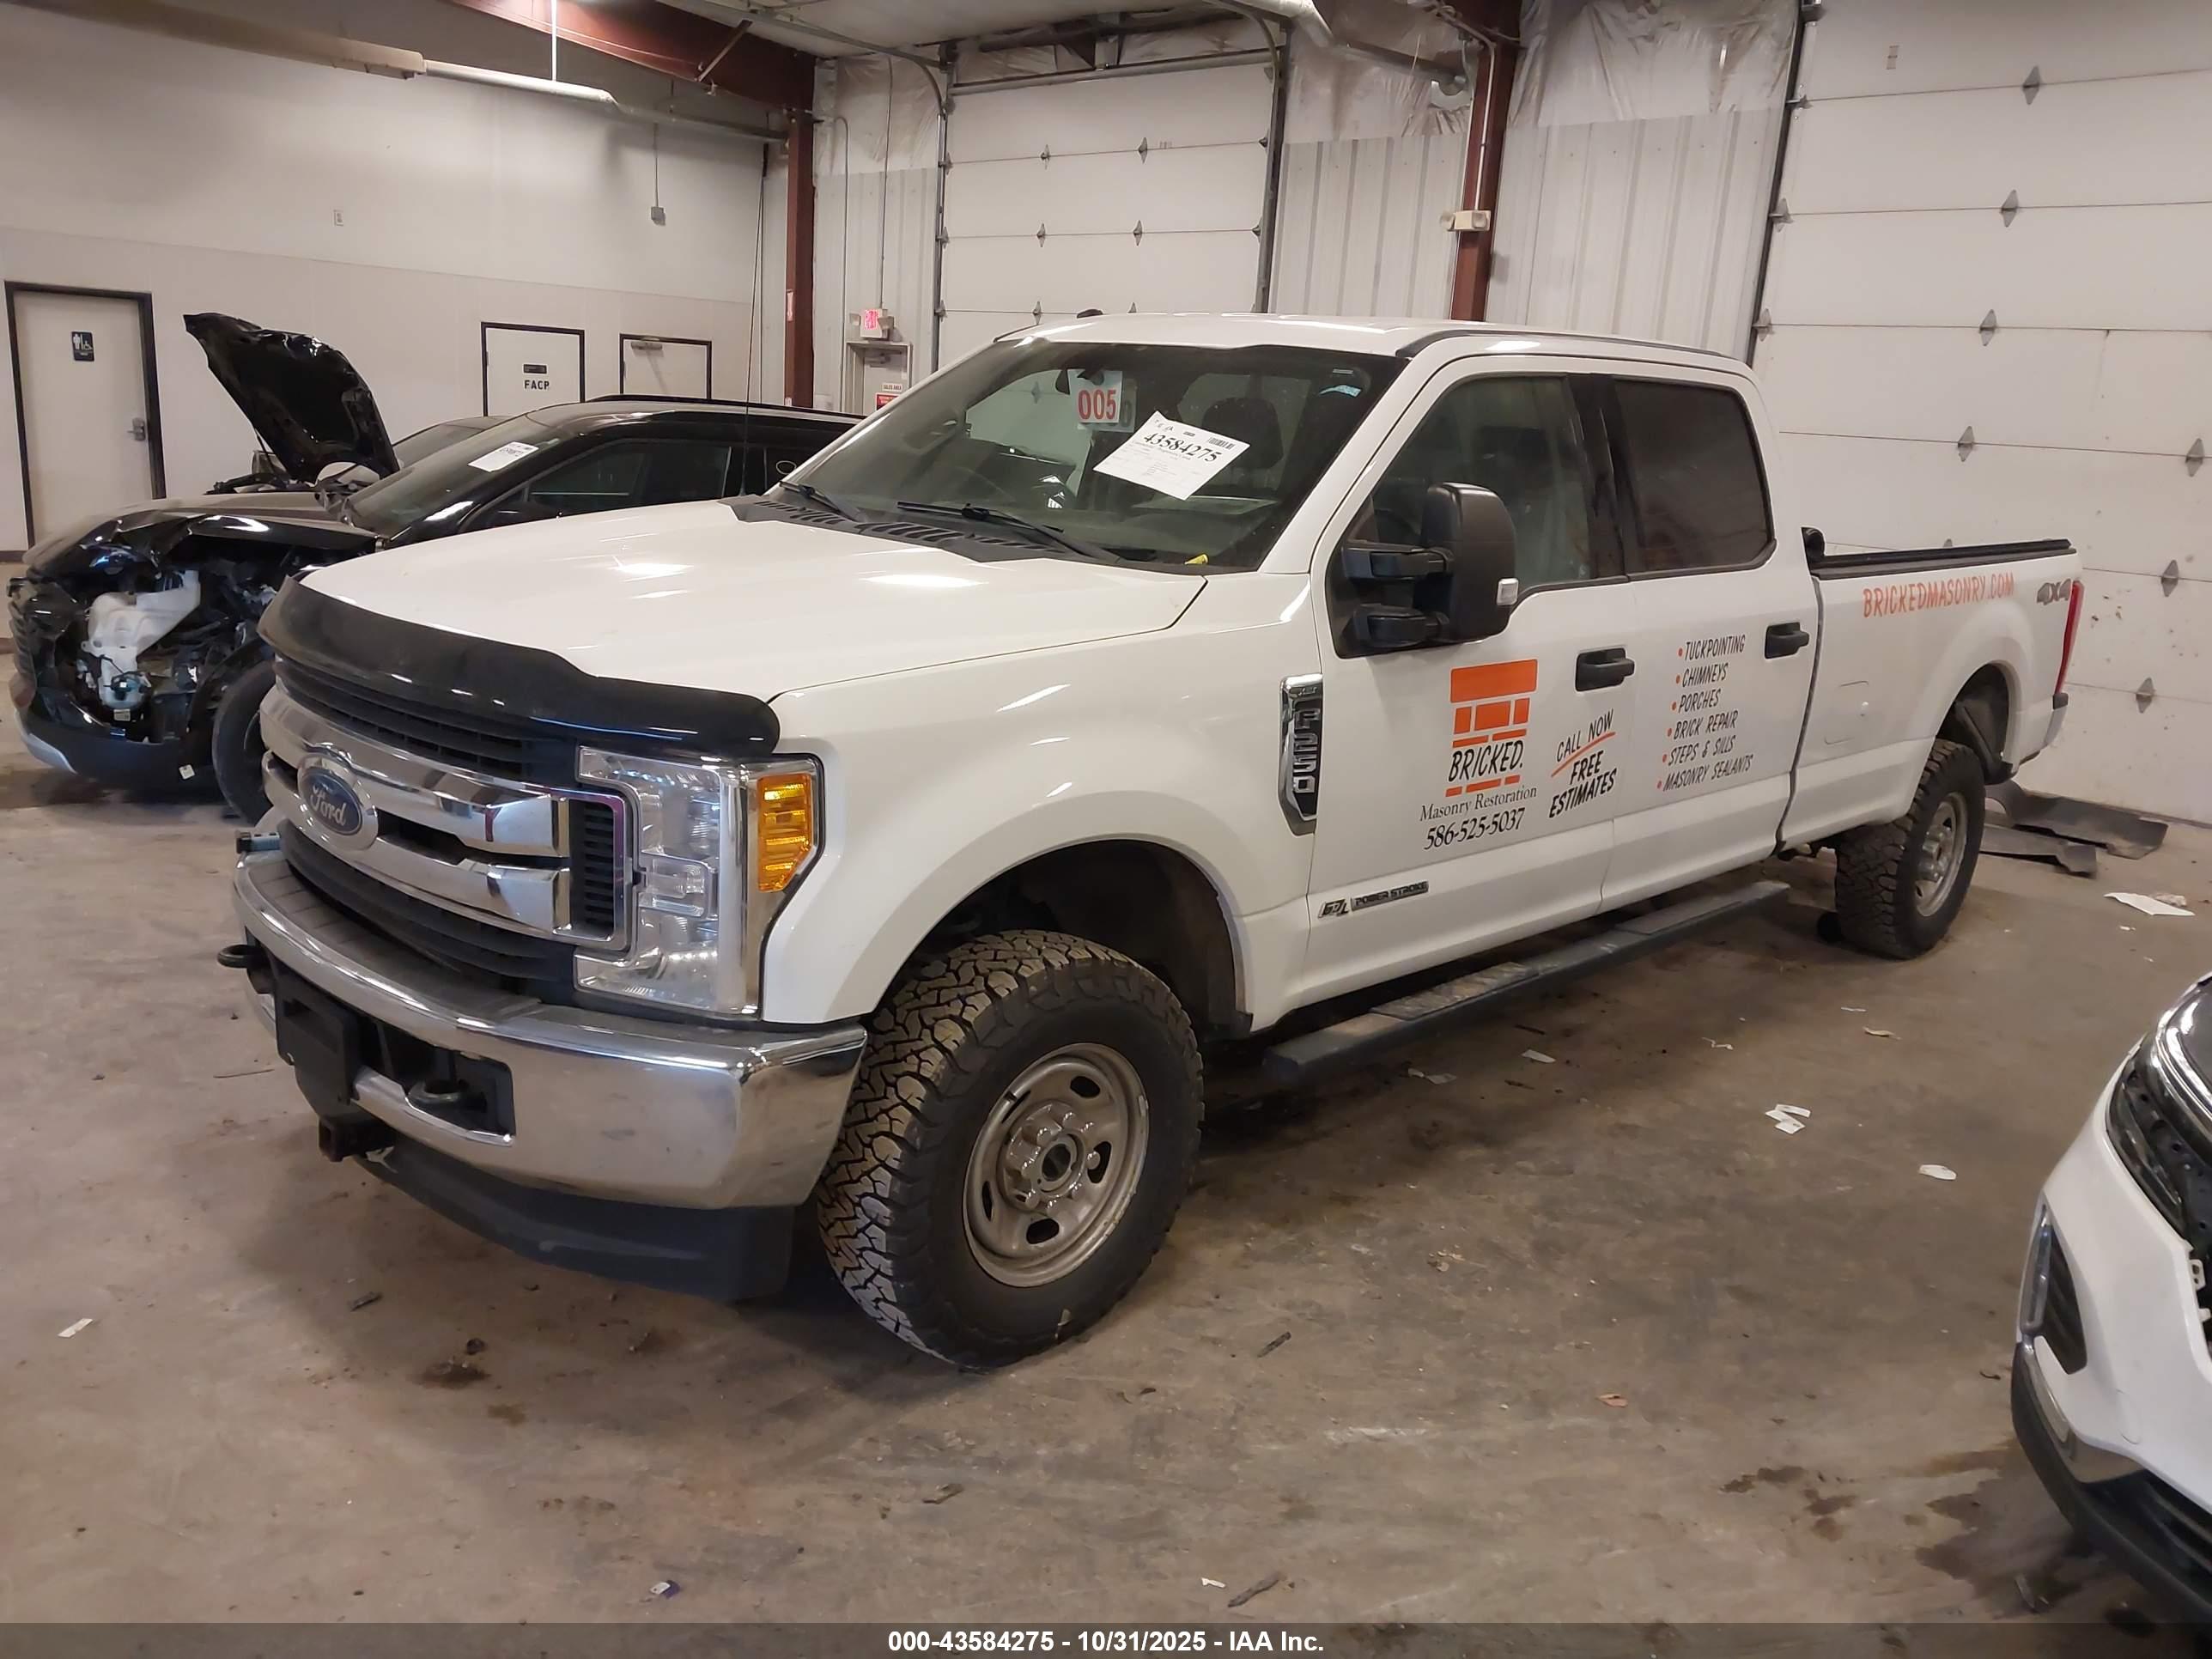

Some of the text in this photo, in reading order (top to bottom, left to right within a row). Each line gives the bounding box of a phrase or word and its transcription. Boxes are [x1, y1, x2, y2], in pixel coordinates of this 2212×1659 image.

[524, 380, 550, 390] FACP
[1078, 389, 1116, 420] 005
[1144, 432, 1223, 463] 43584275
[1863, 571, 2014, 618] BRICKEDMASONRY.COM
[1684, 634, 1746, 660] TUCKPOINTING
[1682, 662, 1729, 688] CHIMNEYS
[1678, 688, 1722, 714] PORCHES
[1556, 708, 1613, 763] CALL NOW
[1673, 709, 1739, 740] BRICK REPAIR
[1448, 739, 1524, 782] BRICKED.
[1570, 750, 1604, 785] FREE
[1668, 734, 1736, 766] STEPS & SILLS
[1662, 754, 1753, 792] MASONRY SEALANTS
[310, 784, 347, 826] Ford
[1419, 785, 1537, 822] Masonry Restoration
[1549, 768, 1617, 818] ESTIMATES
[1423, 807, 1526, 850] 586-525-5037
